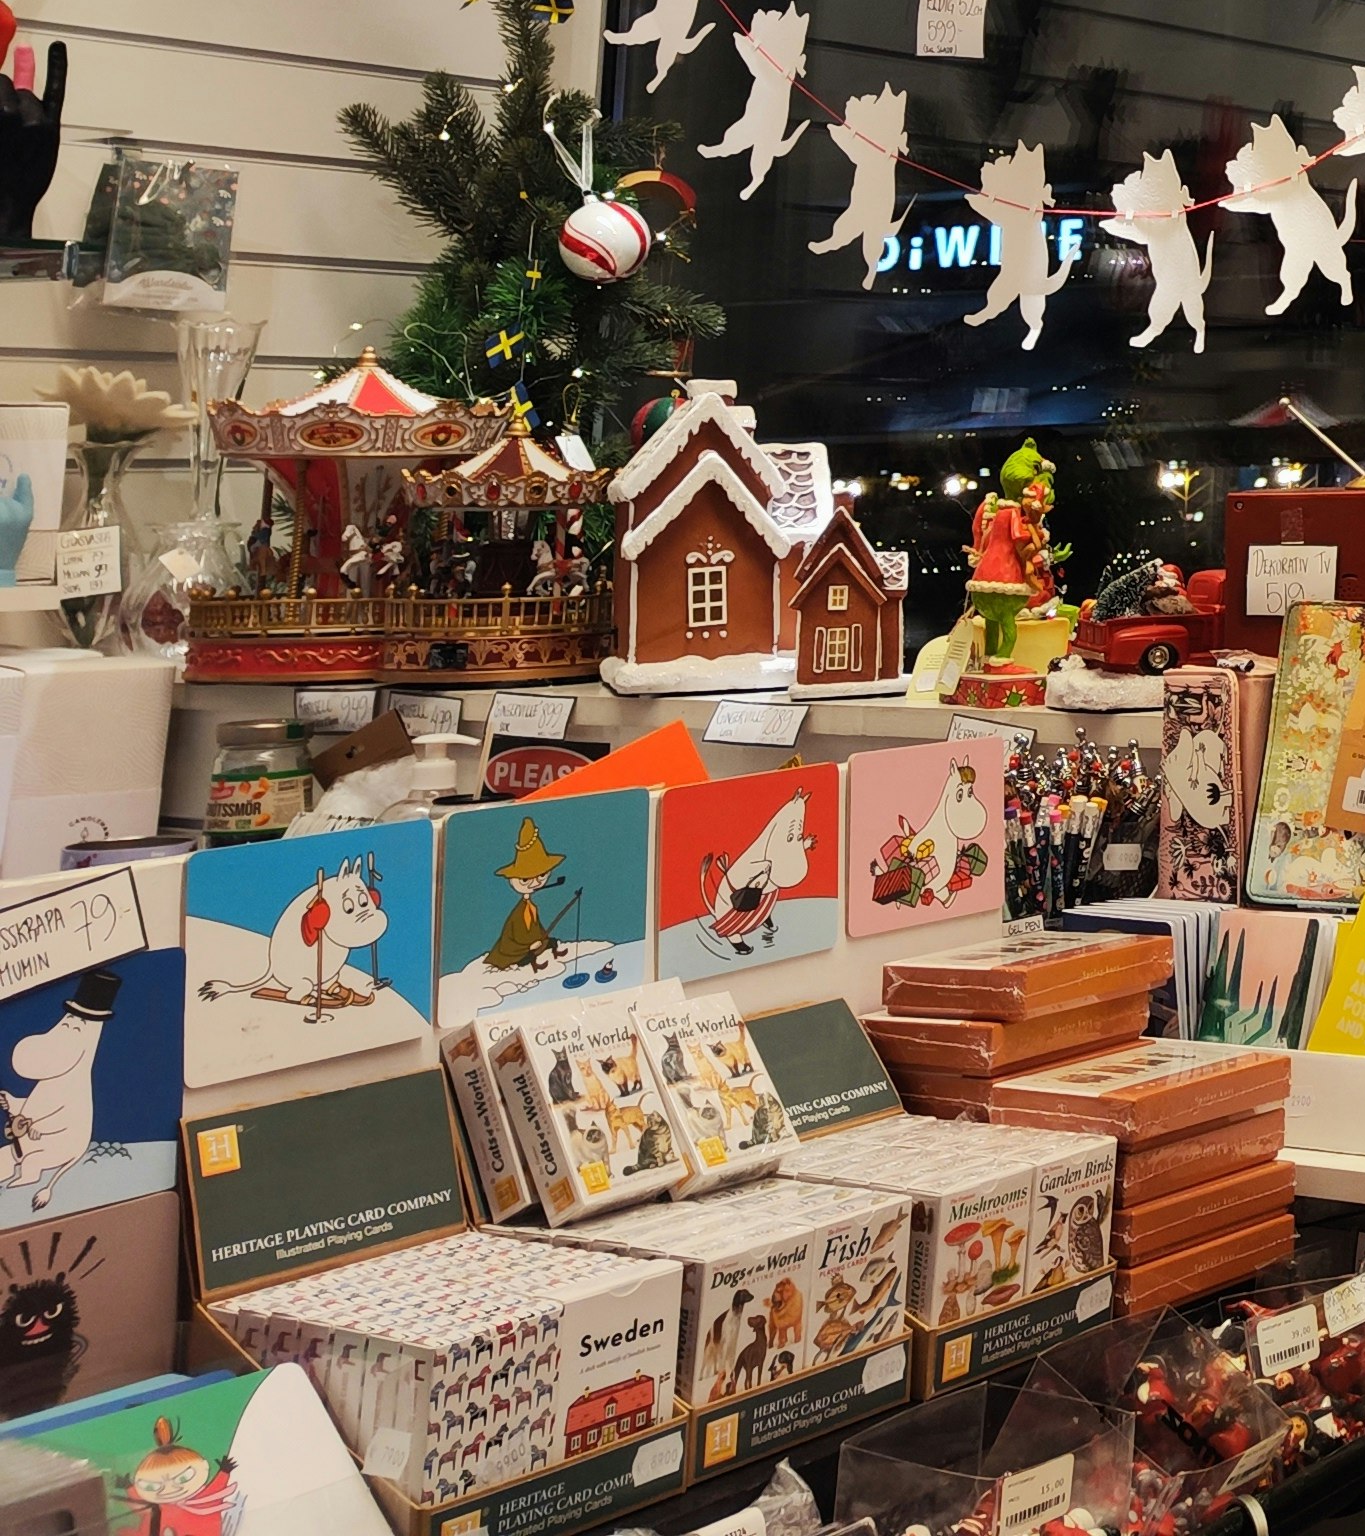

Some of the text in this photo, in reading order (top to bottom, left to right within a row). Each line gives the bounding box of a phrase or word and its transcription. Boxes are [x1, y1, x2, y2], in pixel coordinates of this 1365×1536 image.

[494, 762, 583, 789] PLEAS
[1007, 919, 1041, 936] GEL PEN
[535, 1025, 581, 1047] Cats of
[646, 1013, 691, 1033] Cats of
[678, 1014, 738, 1040] the World
[1335, 1017, 1364, 1040] AND
[567, 1026, 631, 1056] the World
[464, 1067, 490, 1118] World
[512, 1073, 539, 1121] World
[812, 1080, 889, 1110] CARD COMPANY
[1039, 1154, 1114, 1194] Garden Birds
[948, 1186, 1028, 1224] Mushrooms
[212, 1189, 453, 1263] HERITAGE PLAYING CARD COMPANY
[275, 1221, 394, 1261] Illustrated Playing Cards
[818, 1227, 872, 1270] Fish
[710, 1244, 808, 1291] Dogs World
[579, 1317, 665, 1358] Sweden
[984, 1314, 1031, 1341] HERITAGE
[753, 1390, 808, 1419] HERITAGE
[499, 1482, 566, 1515] HERITAGE
